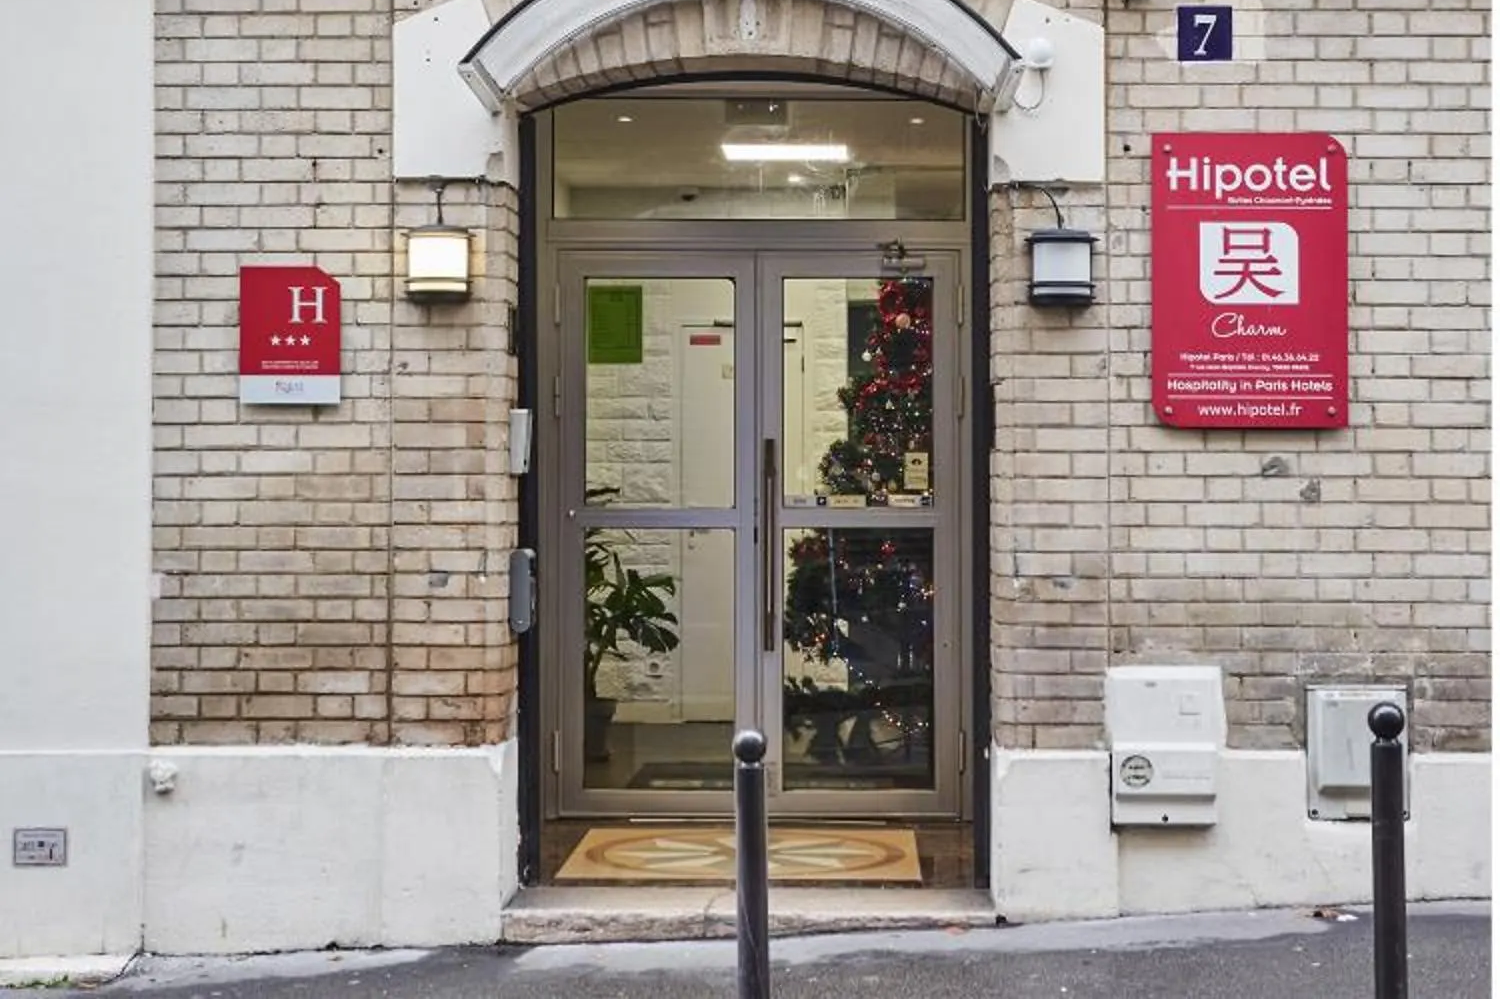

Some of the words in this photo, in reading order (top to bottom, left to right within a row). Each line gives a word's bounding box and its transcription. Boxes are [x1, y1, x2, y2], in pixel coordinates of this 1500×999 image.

[1194, 14, 1217, 56] 7
[1166, 156, 1331, 199] Hipotel
[287, 286, 328, 324] H
[1211, 312, 1287, 338] Charm
[1167, 380, 1237, 394] Hospitality
[1240, 380, 1253, 390] in
[1255, 380, 1288, 391] Paris
[1291, 380, 1333, 392] Hotels
[1197, 402, 1303, 417] www.hipotel.fr
